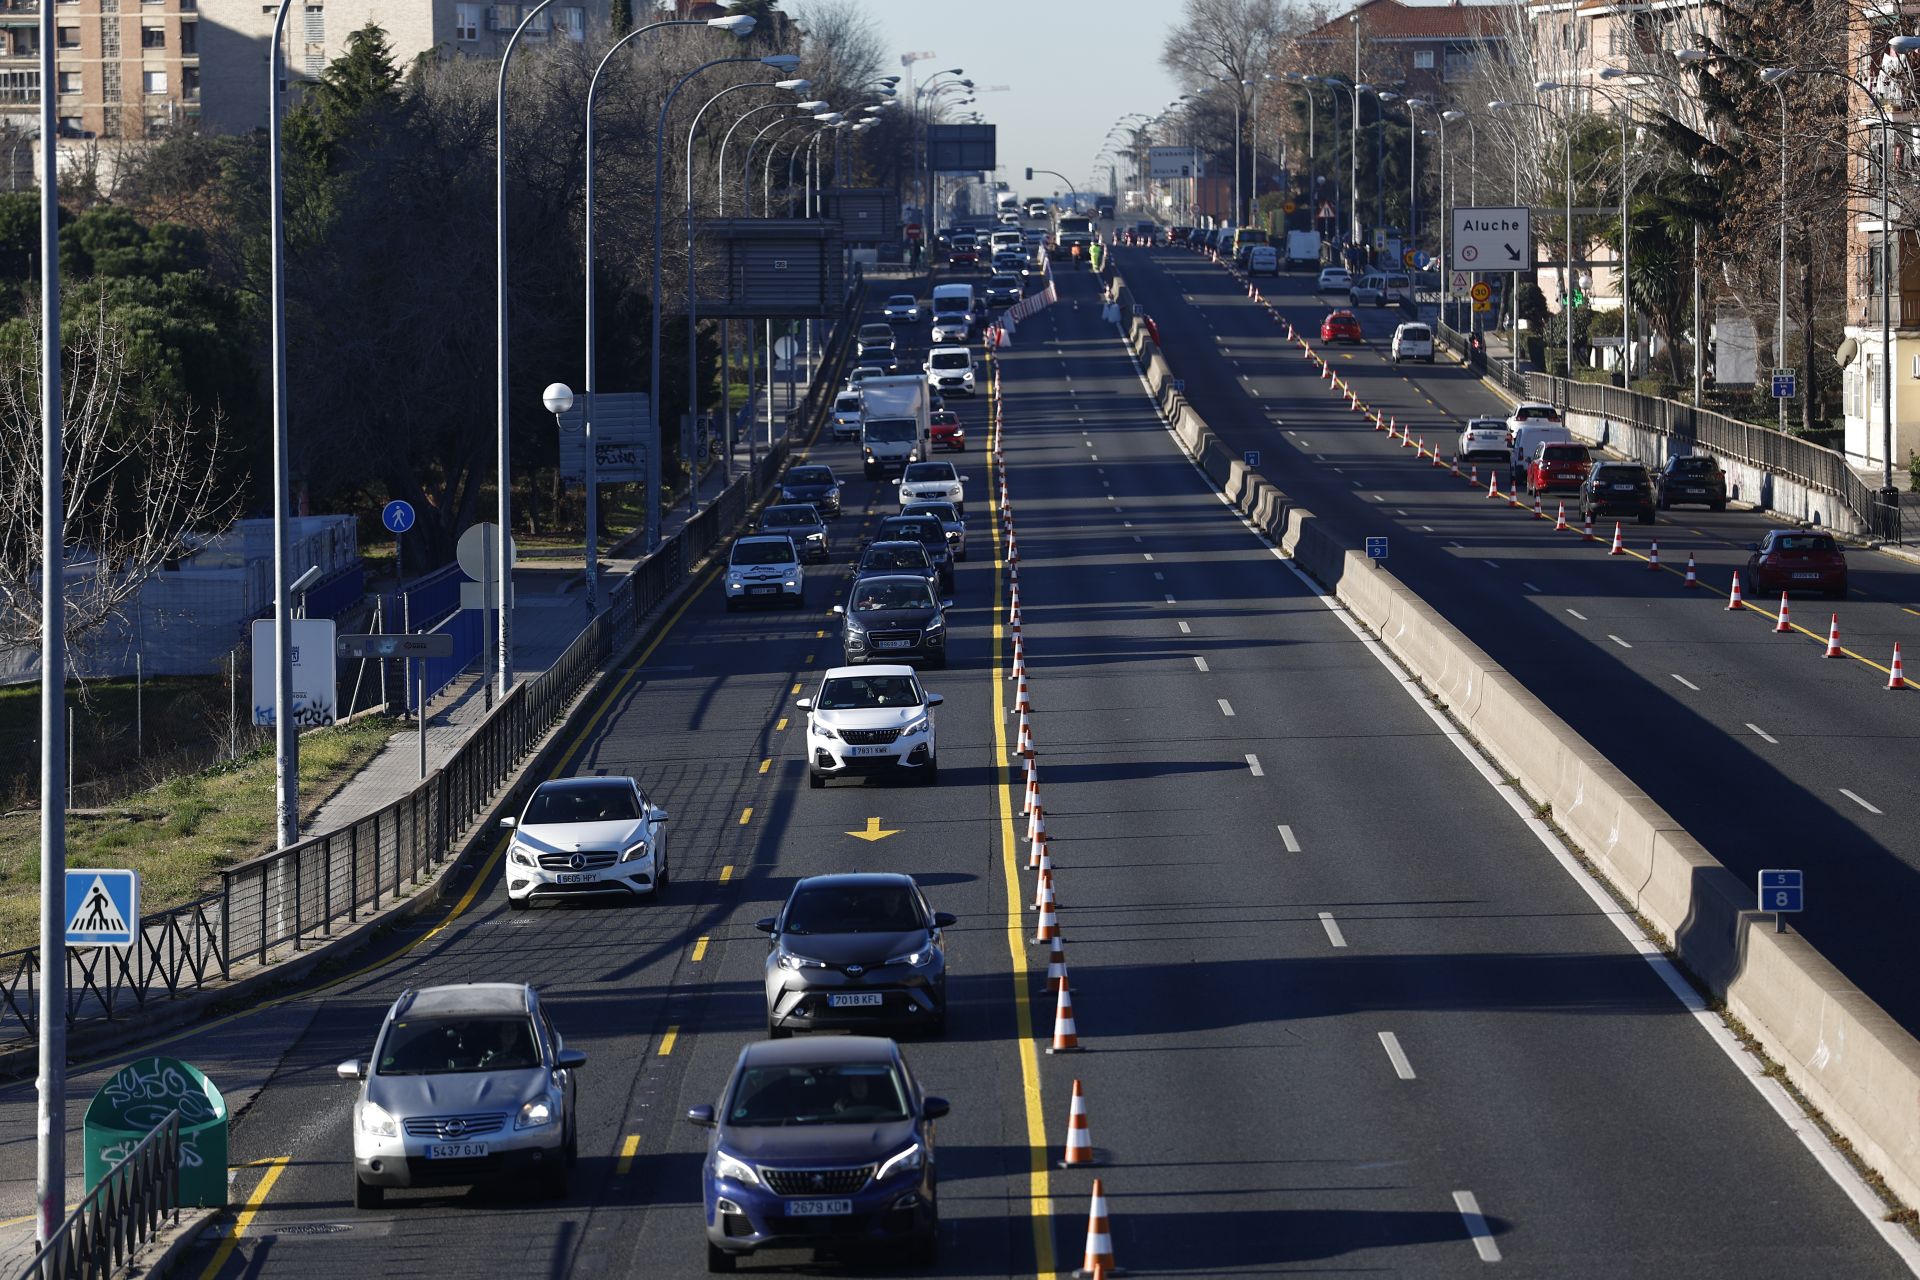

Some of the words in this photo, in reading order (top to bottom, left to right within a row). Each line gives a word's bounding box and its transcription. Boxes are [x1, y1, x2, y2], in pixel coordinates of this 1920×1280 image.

[1463, 220, 1520, 231] Aluche
[1475, 286, 1487, 296] 30
[1374, 547, 1381, 556] 9
[1777, 874, 1786, 884] 5
[1775, 891, 1788, 907] 8
[835, 995, 860, 1005] 7018
[861, 994, 881, 1005] KFL
[433, 1145, 460, 1157] 5437
[464, 1144, 485, 1156] GJV
[793, 1201, 824, 1214] 2679
